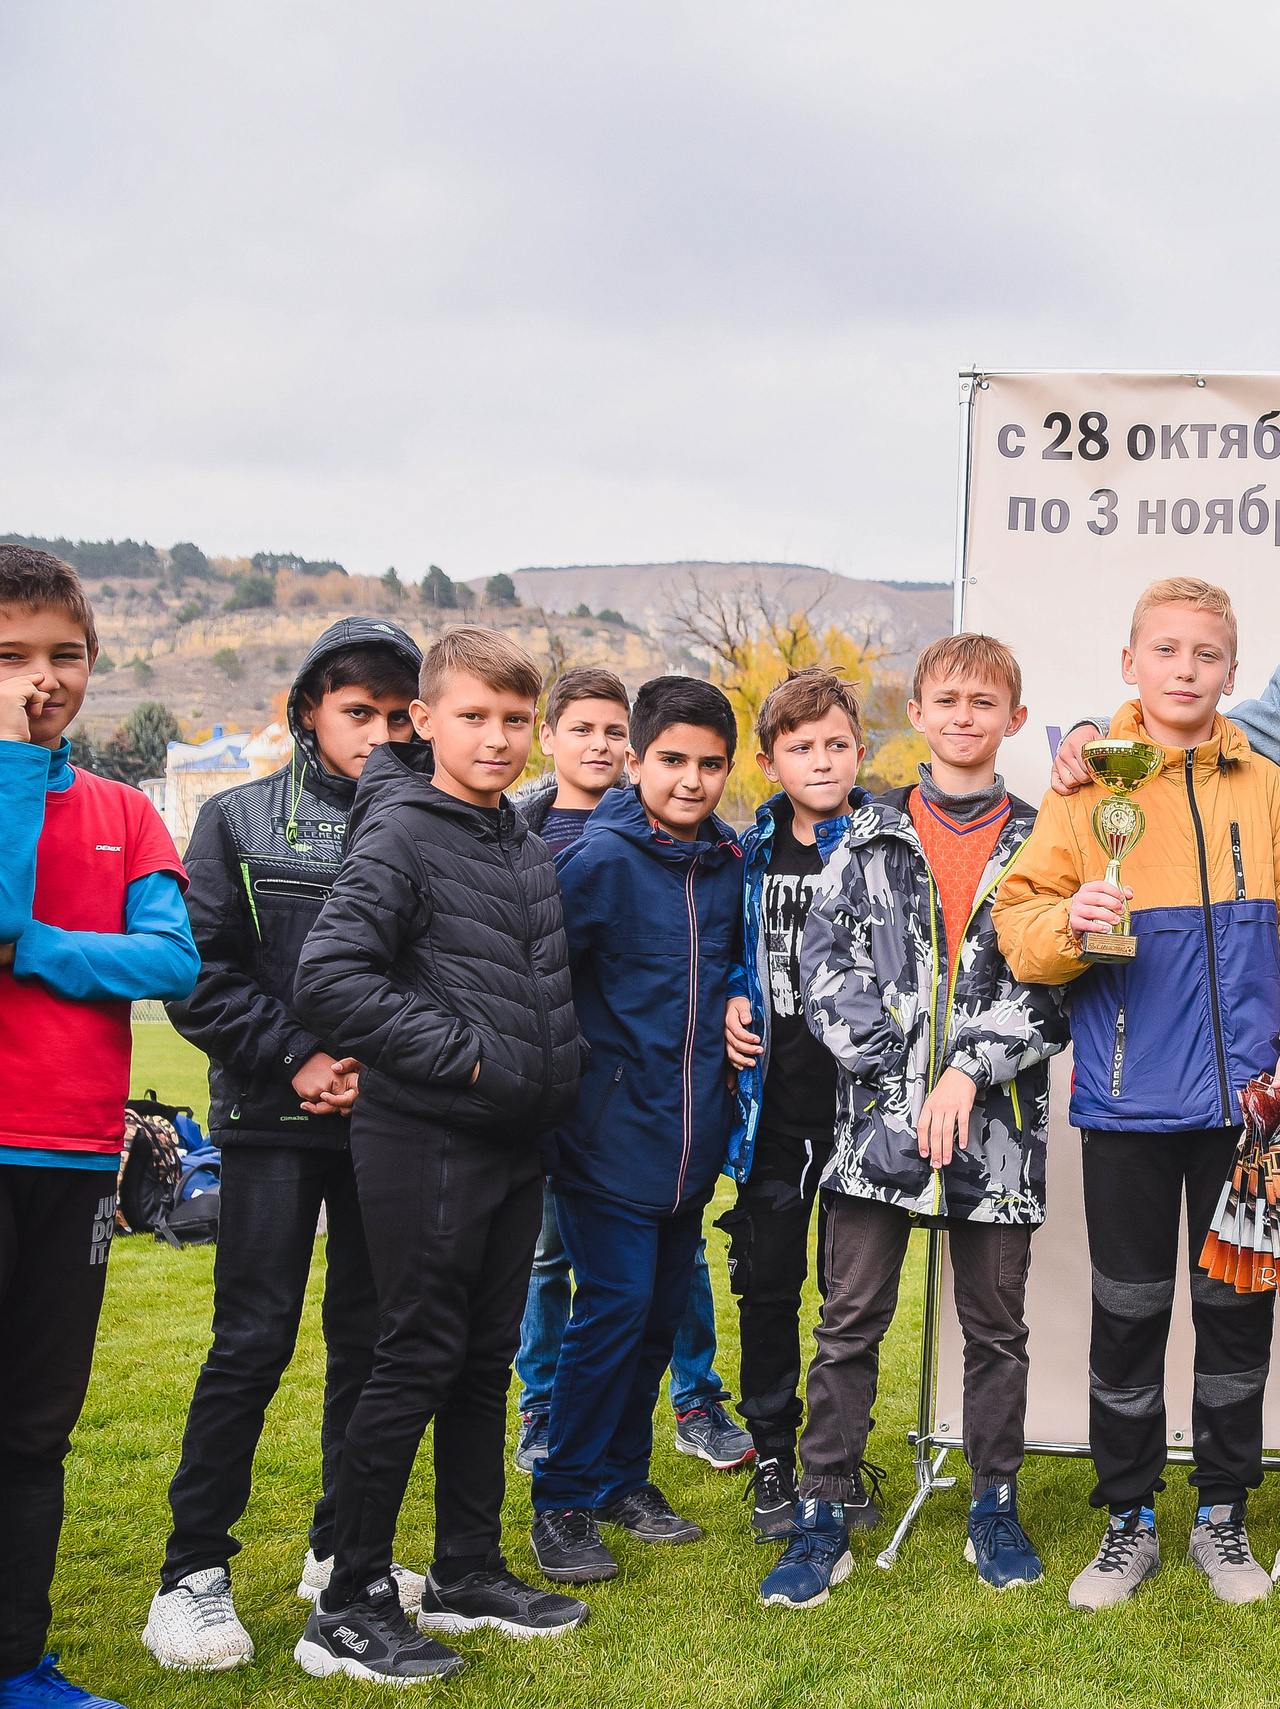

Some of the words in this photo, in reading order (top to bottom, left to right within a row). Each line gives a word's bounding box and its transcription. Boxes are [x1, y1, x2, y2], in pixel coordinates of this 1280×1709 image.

[996, 422, 1027, 459] с
[1041, 410, 1111, 462] 28
[1007, 495, 1071, 535] по
[1086, 487, 1120, 536] 3
[91, 1217, 114, 1243] DO
[369, 1582, 389, 1597] FILA
[332, 1625, 369, 1654] FILA
